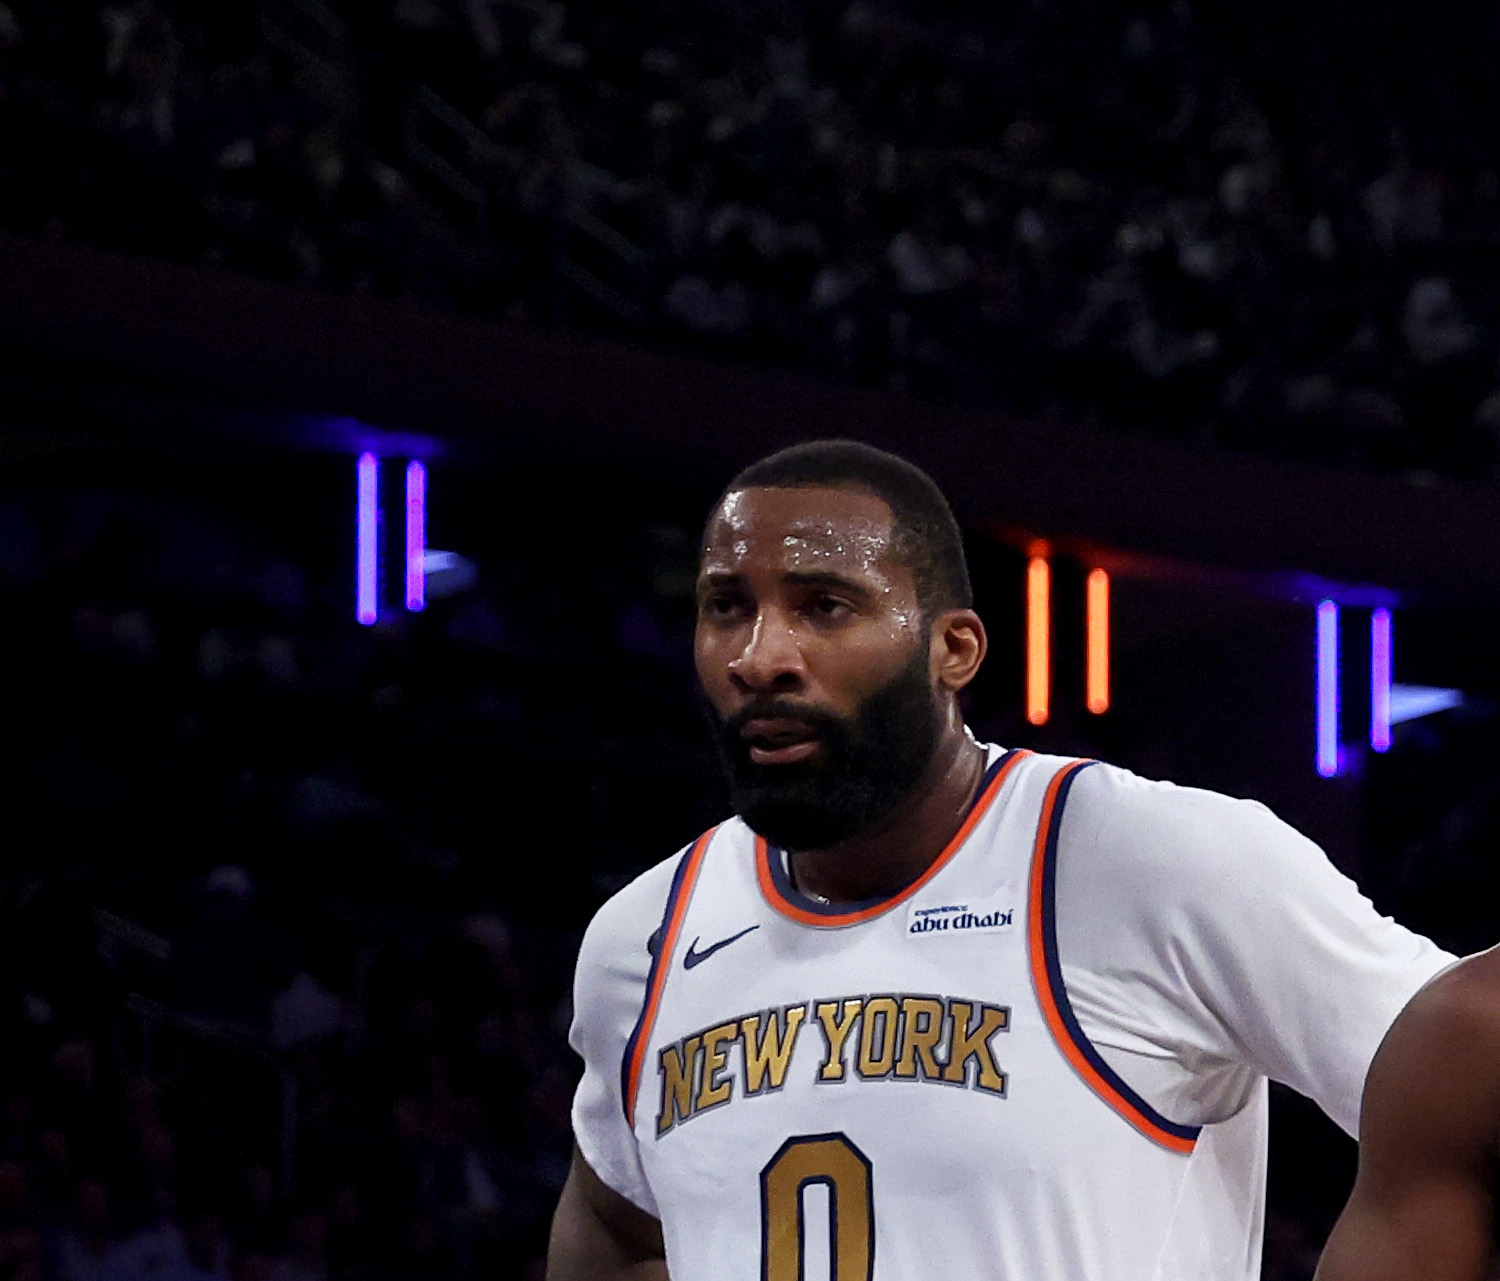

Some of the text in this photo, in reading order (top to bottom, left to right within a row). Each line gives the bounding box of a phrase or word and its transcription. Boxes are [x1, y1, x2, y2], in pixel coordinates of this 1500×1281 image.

[909, 908, 1014, 934] abu dhabi
[655, 992, 1012, 1141] NEW YORK
